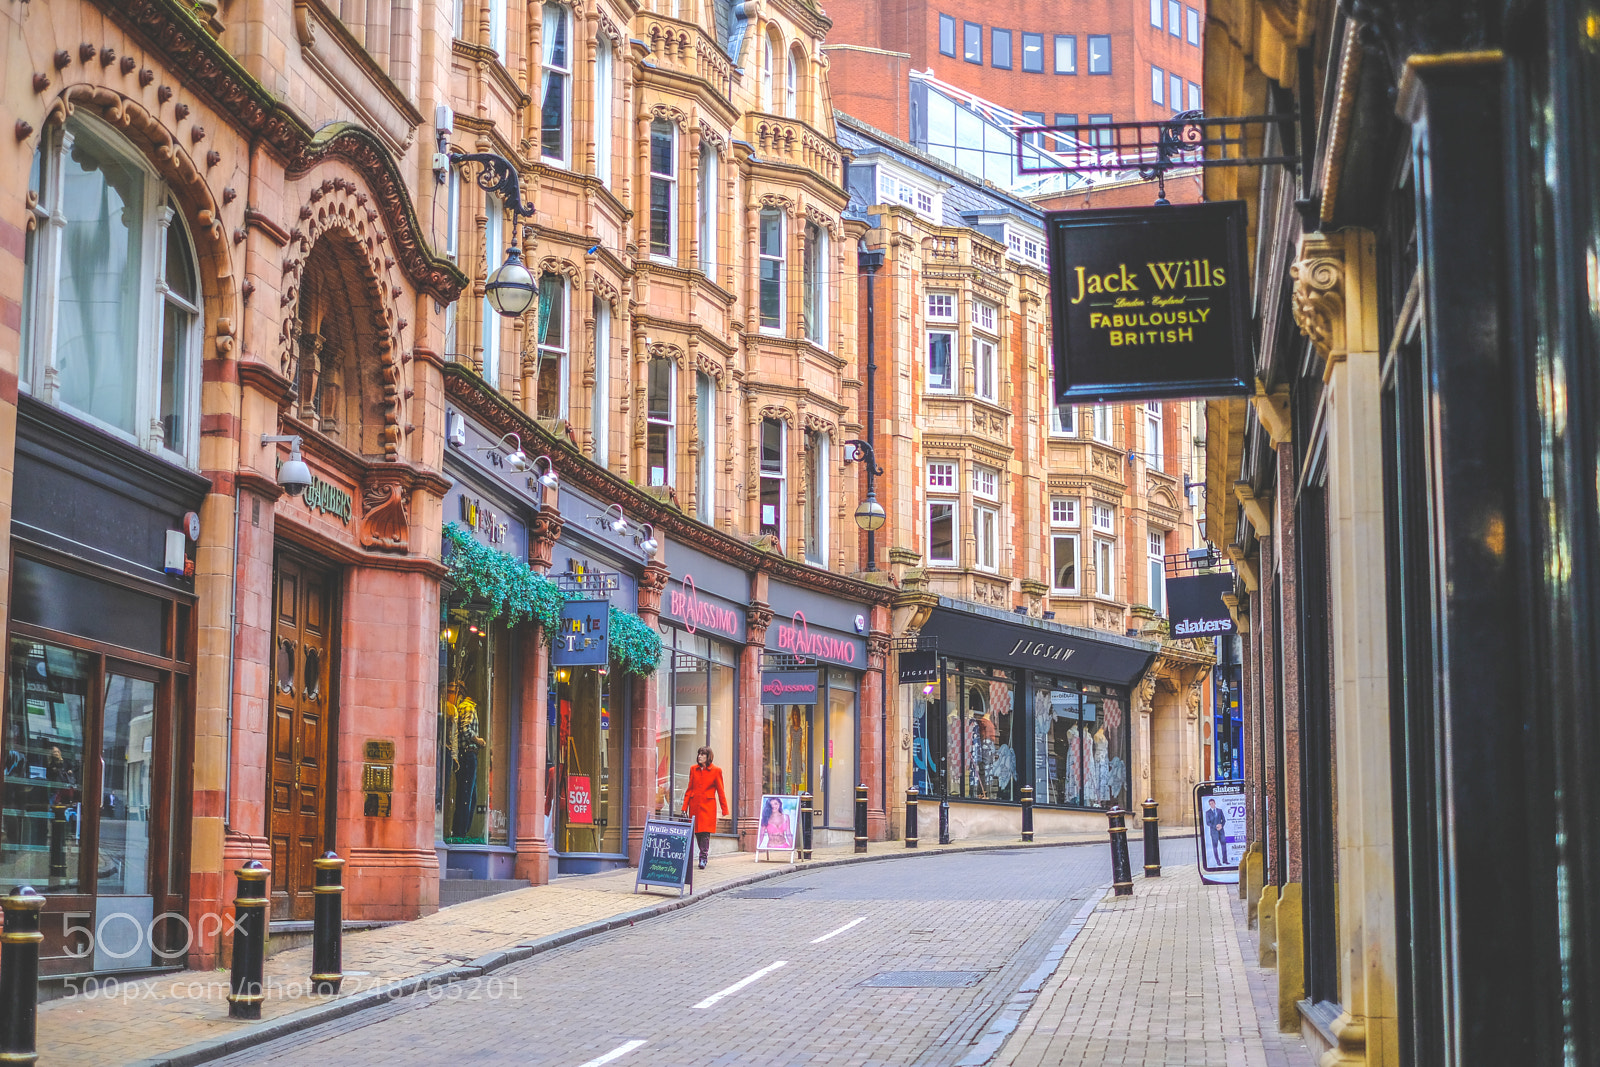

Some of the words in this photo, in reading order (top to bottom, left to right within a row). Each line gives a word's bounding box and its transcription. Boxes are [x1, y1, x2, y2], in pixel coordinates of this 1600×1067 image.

[1071, 264, 1139, 304] Jack
[1147, 260, 1226, 290] Wills
[1113, 297, 1145, 308] London
[1152, 295, 1187, 307] England
[1090, 308, 1211, 328] FABULOUSLY
[1110, 327, 1193, 346] BRITISH
[671, 575, 738, 635] BRAVISSIMO
[1175, 618, 1231, 634] slaters
[778, 611, 855, 664] BRAVISSIMO
[1009, 639, 1075, 661] JIGSAW
[902, 669, 934, 678] JIGSAW
[763, 679, 815, 696] BRAVISSIMO
[1213, 785, 1240, 793] slaters
[569, 791, 590, 805] 50%
[574, 805, 587, 813] OFF
